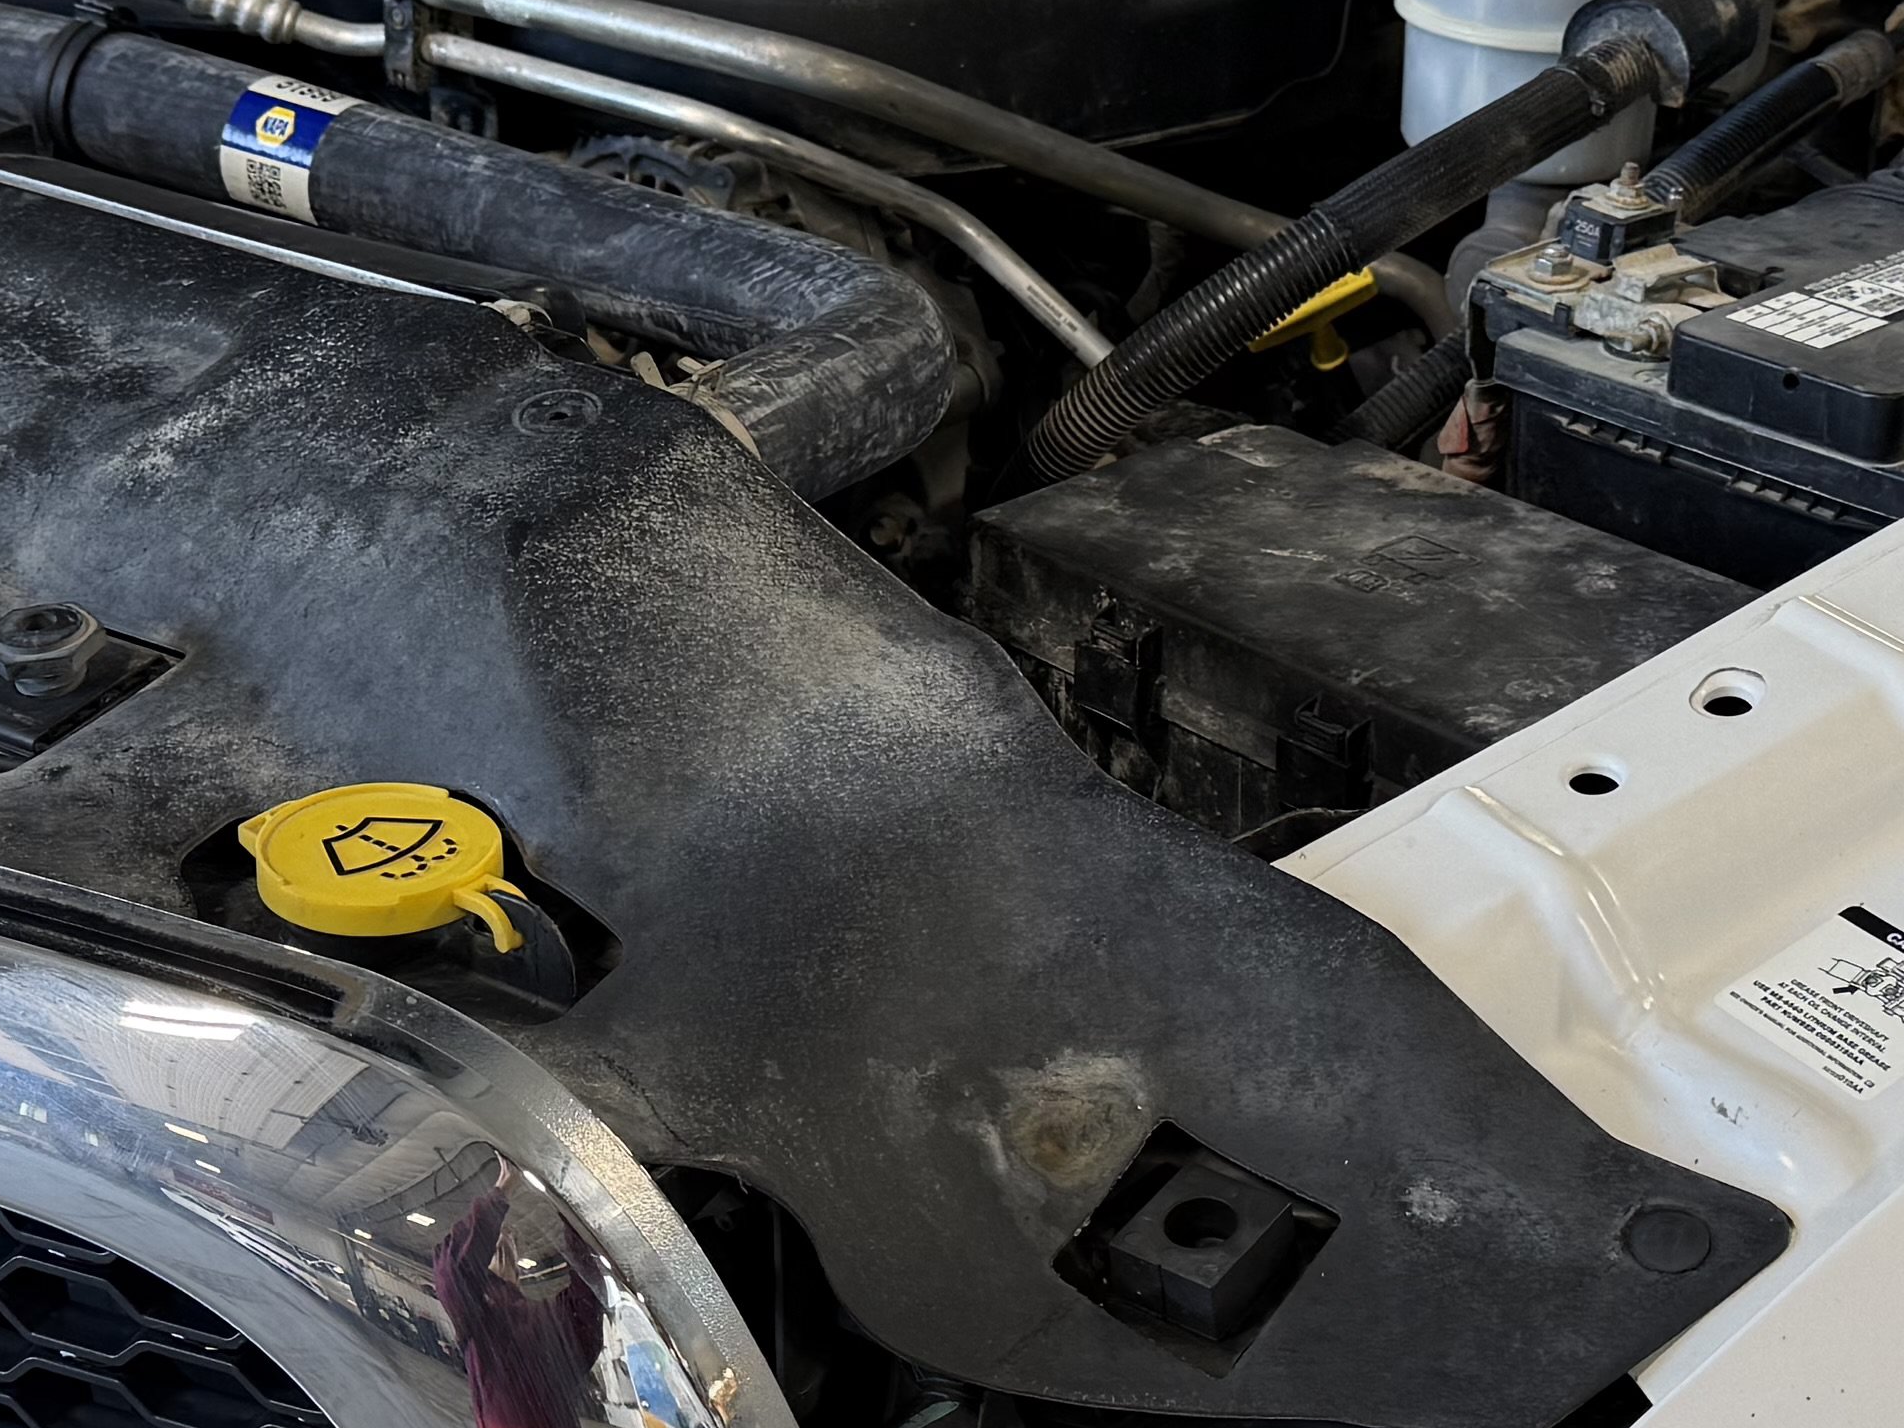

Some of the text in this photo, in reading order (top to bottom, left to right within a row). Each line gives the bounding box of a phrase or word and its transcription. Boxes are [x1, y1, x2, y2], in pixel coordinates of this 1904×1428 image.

[1575, 219, 1601, 238] 250A
[1759, 995, 1783, 1011] PART
[1779, 1009, 1817, 1033] NUMBER
[1776, 980, 1888, 1053] AT EACH OIL CHANGE INTERVAL
[1816, 995, 1845, 1014] FRONT
[1750, 980, 1771, 993] USE
[1801, 1012, 1838, 1036] LITHIUM
[1834, 1033, 1859, 1050] BASE
[1856, 1047, 1892, 1071] GREASE
